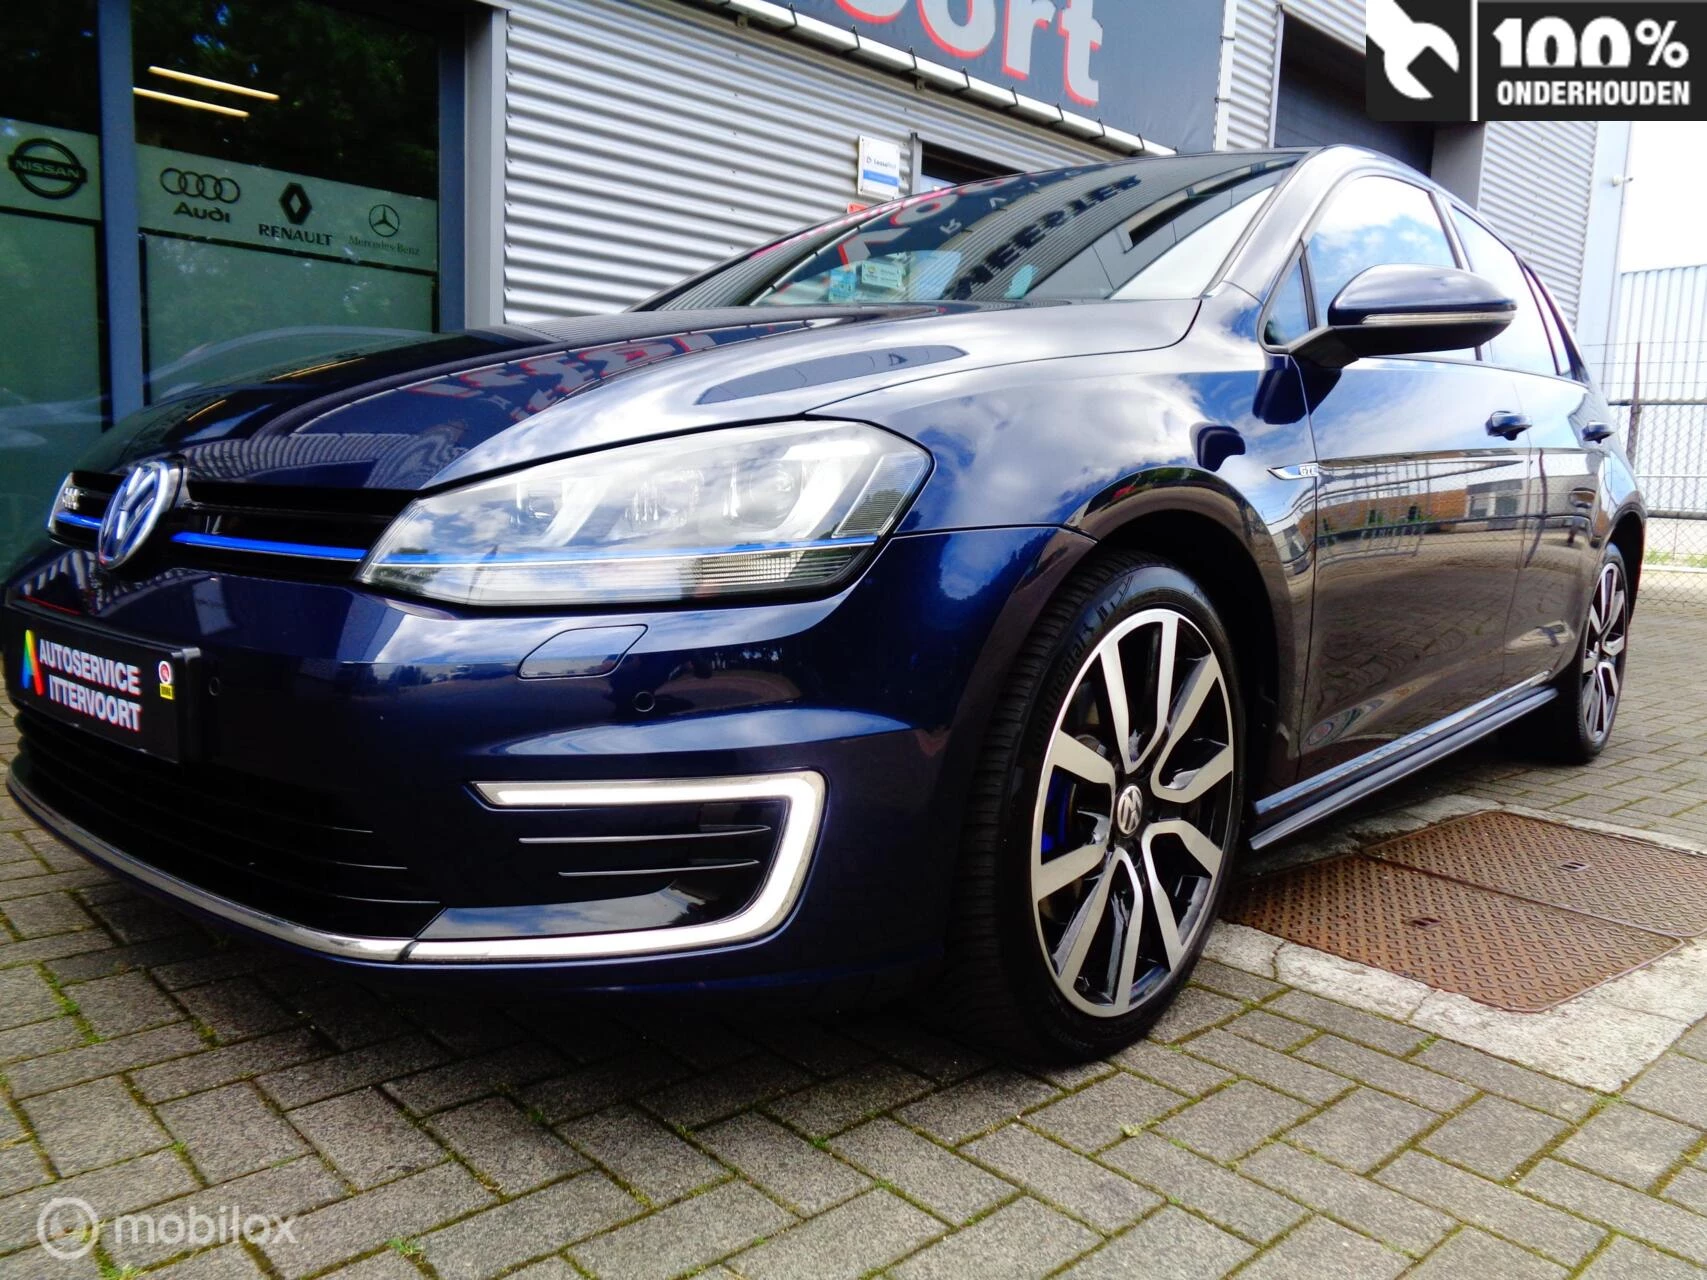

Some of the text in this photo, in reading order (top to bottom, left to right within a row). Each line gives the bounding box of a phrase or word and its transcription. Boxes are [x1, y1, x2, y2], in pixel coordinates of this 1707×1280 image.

[15, 160, 80, 179] NISSAN
[173, 202, 230, 223] Audi
[258, 223, 333, 246] RENAULT
[39, 638, 142, 696] AUTOSERVICE
[49, 674, 142, 732] ITTERVOORT
